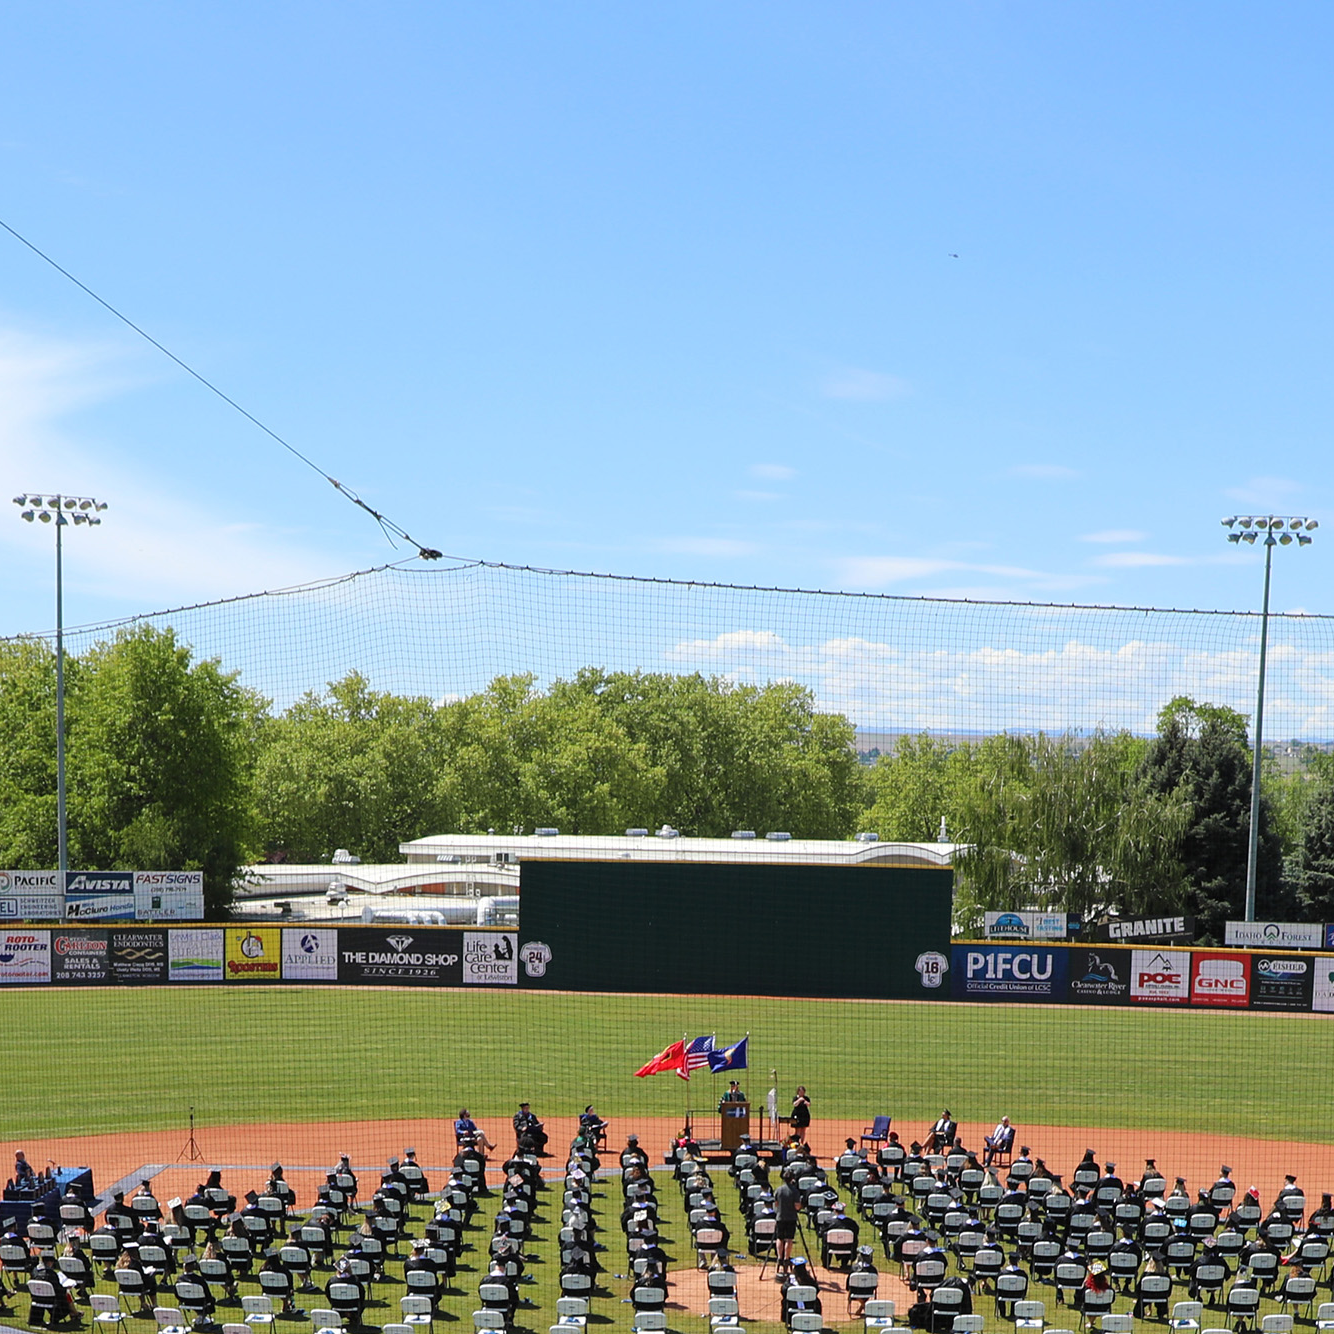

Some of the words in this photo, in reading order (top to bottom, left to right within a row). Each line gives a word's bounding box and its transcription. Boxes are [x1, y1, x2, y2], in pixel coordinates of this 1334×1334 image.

[14, 875, 57, 886] PACIFIC
[68, 875, 131, 890] AVISTA
[1108, 916, 1185, 938] GRANITE
[5, 935, 39, 943] ROTO-
[1235, 929, 1262, 939] IDAHO
[1281, 931, 1313, 942] FOREST
[4, 943, 48, 951] ROOTER
[466, 941, 488, 953] Life
[342, 952, 366, 964] THE
[368, 952, 423, 965] DIAMOND
[424, 954, 459, 966] SHOP
[464, 953, 493, 964] Care
[528, 951, 543, 964] 24
[364, 967, 405, 975] SINCE
[470, 962, 510, 974] Center
[924, 962, 939, 974] 16
[966, 951, 1053, 980] P1FCU
[1071, 980, 1108, 990] Clearwater
[1108, 981, 1127, 991] River
[1138, 972, 1182, 988] POE
[1197, 978, 1245, 989] GNC
[1034, 984, 1052, 992] LCSC
